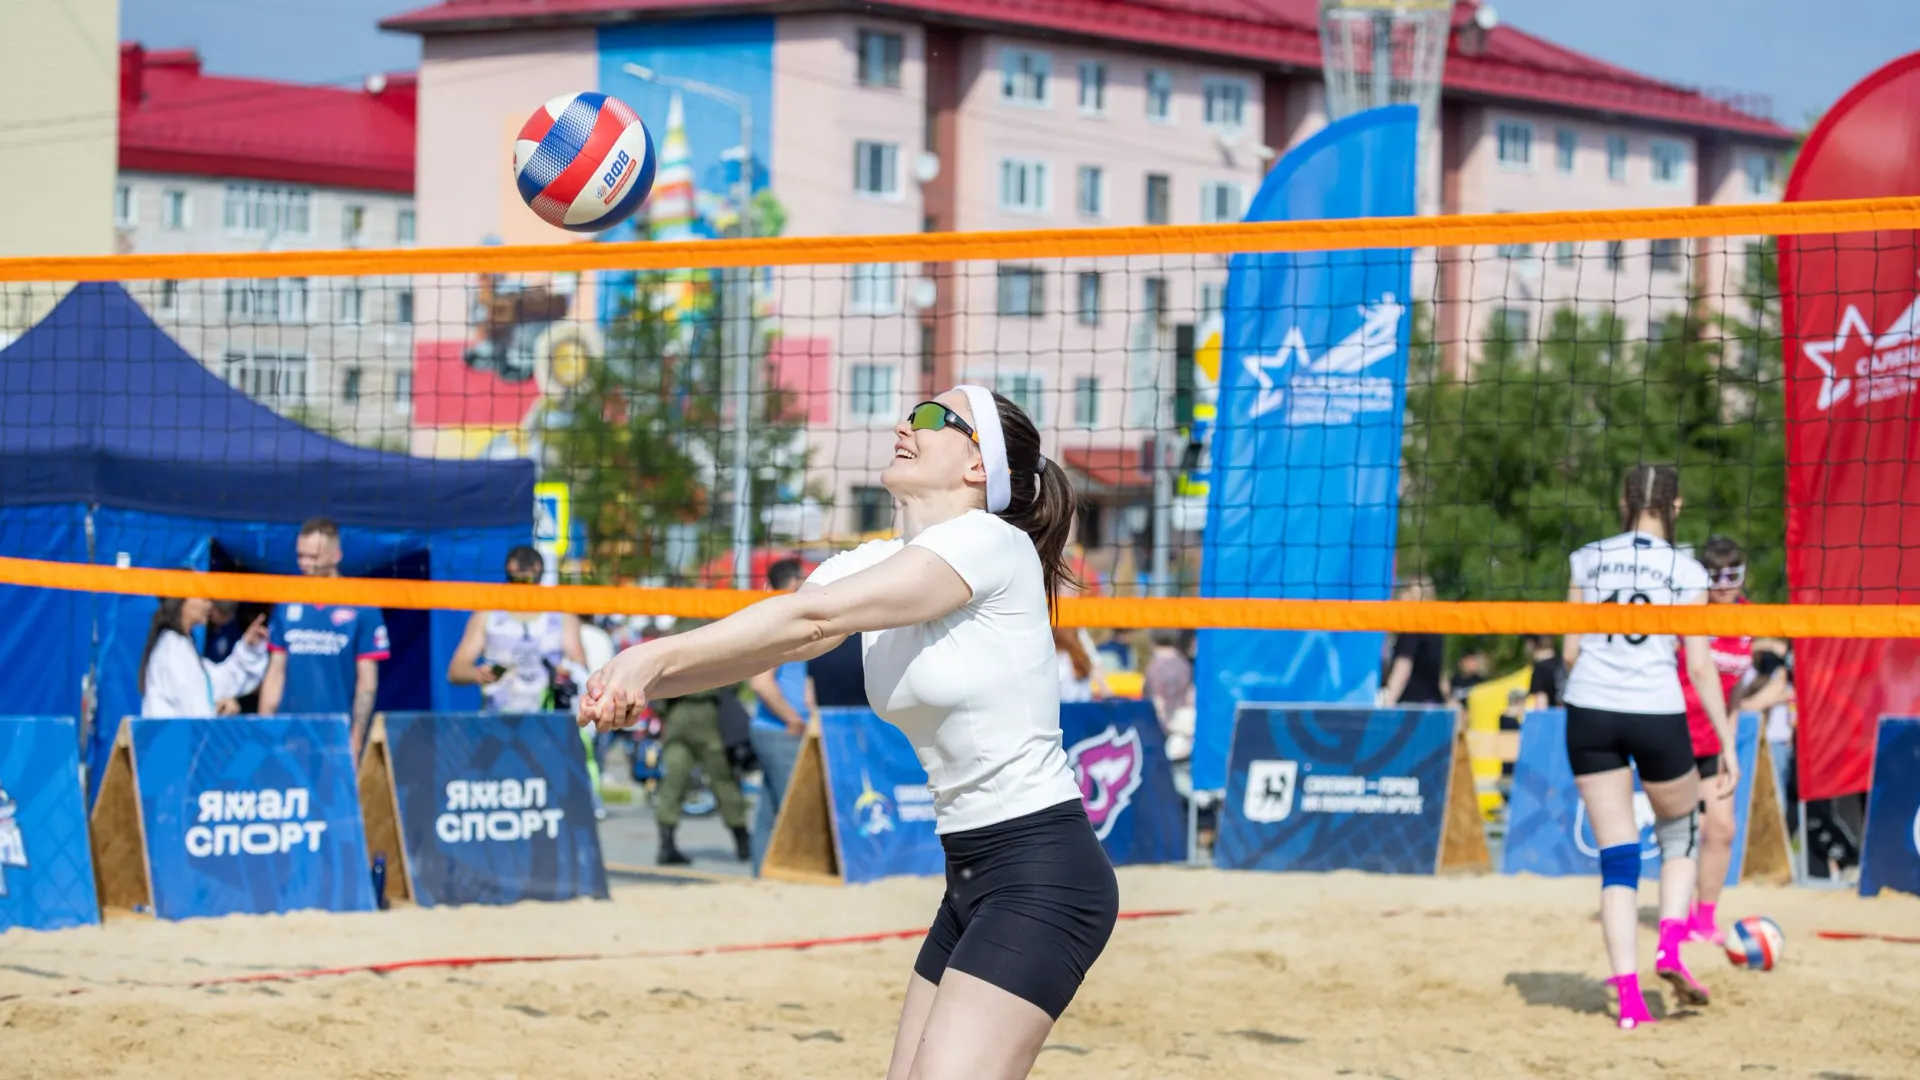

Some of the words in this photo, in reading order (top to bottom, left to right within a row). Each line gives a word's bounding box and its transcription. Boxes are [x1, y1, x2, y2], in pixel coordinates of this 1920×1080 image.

[604, 150, 629, 188] ВФВ
[185, 820, 328, 858] СПОРТ
[435, 808, 565, 843] СПОРТ
